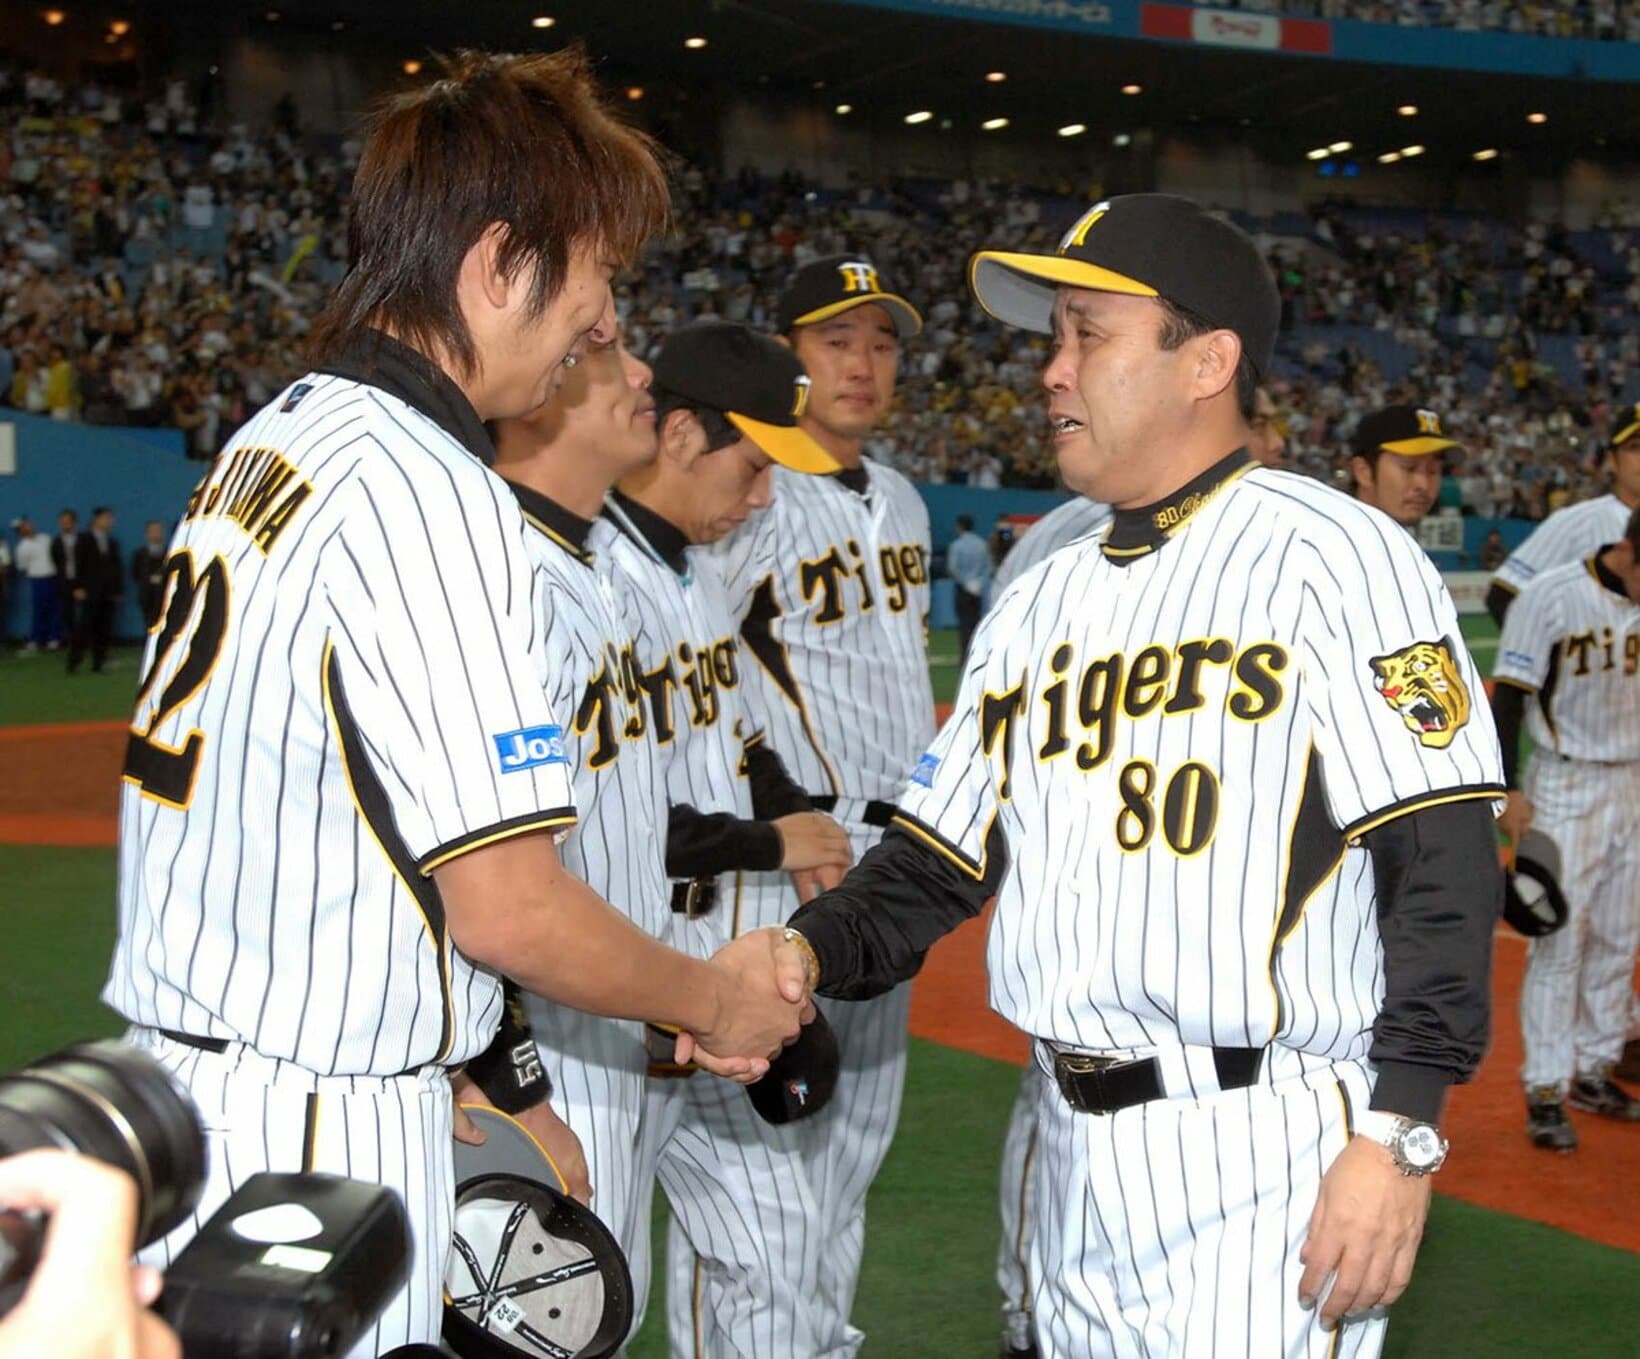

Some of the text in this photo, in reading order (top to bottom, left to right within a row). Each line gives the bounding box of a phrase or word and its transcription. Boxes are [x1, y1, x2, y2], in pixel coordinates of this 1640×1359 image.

[121, 546, 230, 812] 22
[980, 637, 1289, 803] Tigers
[1114, 757, 1221, 859] 80
